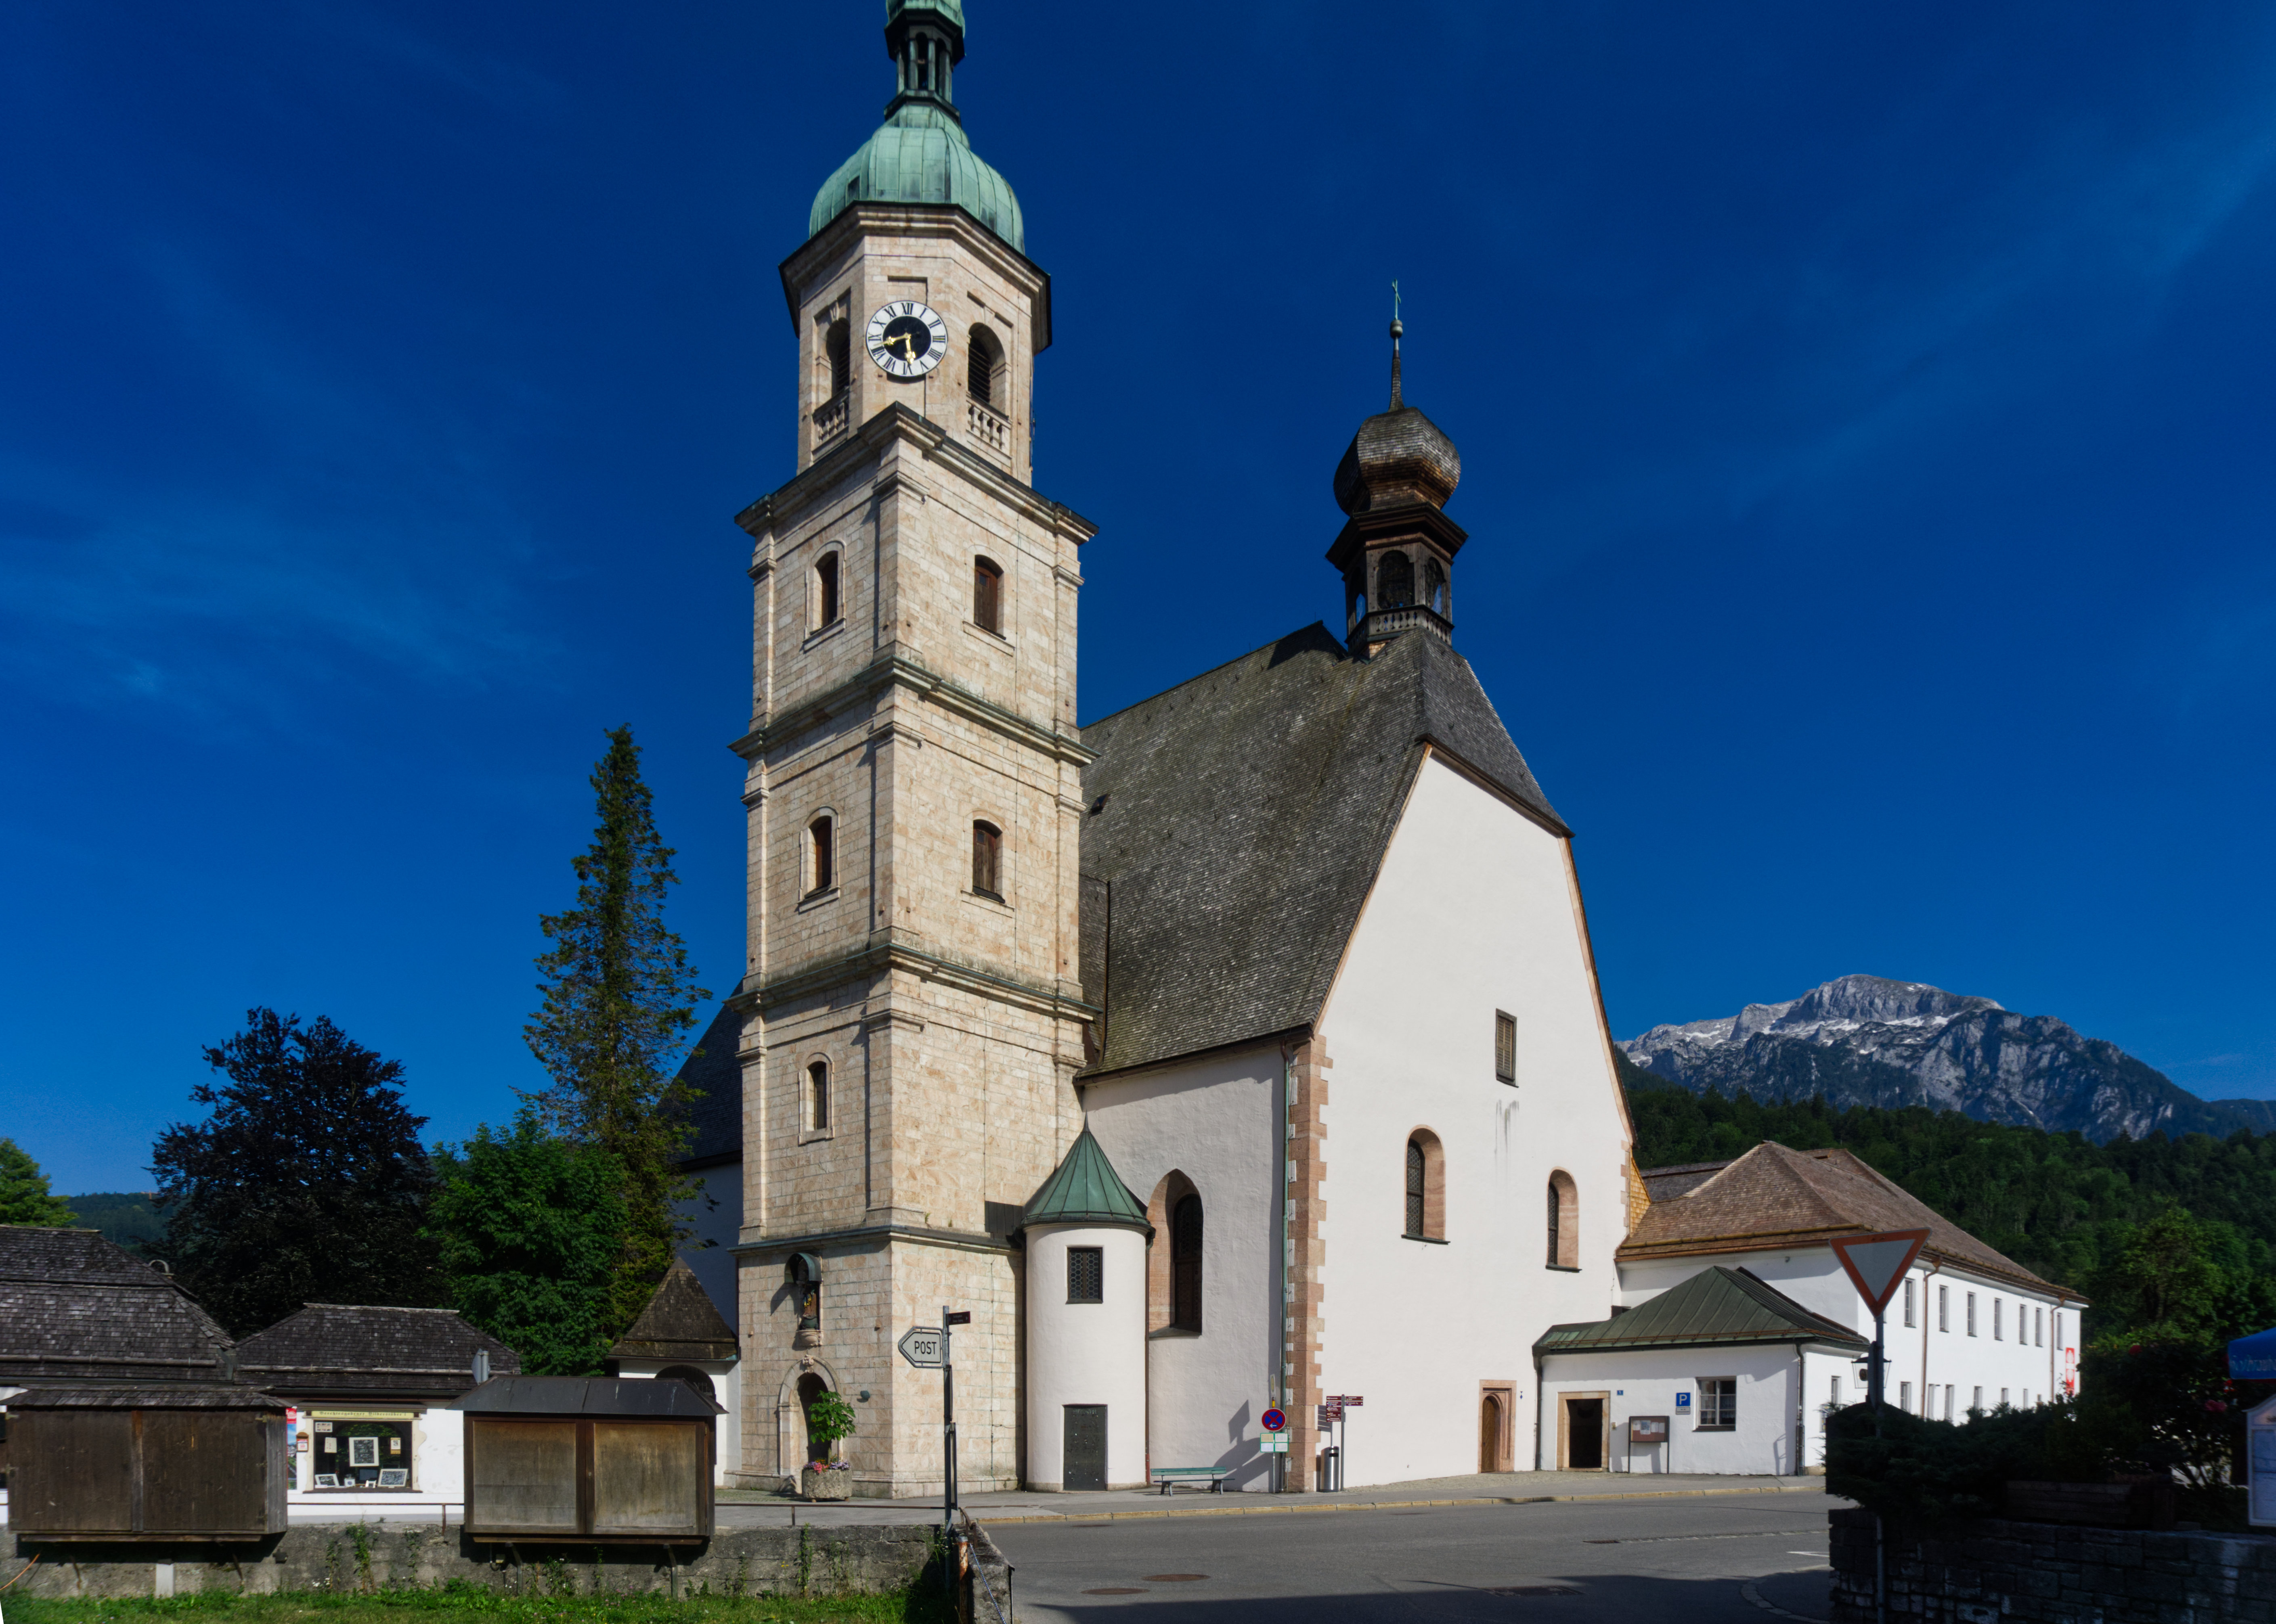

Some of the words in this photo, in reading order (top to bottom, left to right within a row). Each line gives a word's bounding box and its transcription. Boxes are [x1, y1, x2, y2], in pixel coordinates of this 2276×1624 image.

[883, 306, 897, 320] XI
[901, 303, 914, 315] XII
[919, 307, 928, 318] I
[872, 316, 887, 329] X
[928, 318, 943, 329] II
[868, 333, 882, 342] IX
[933, 334, 945, 344] III
[883, 357, 896, 373] VII
[920, 360, 929, 372] V
[914, 1341, 937, 1354] POST
[1679, 1394, 1687, 1405] P
